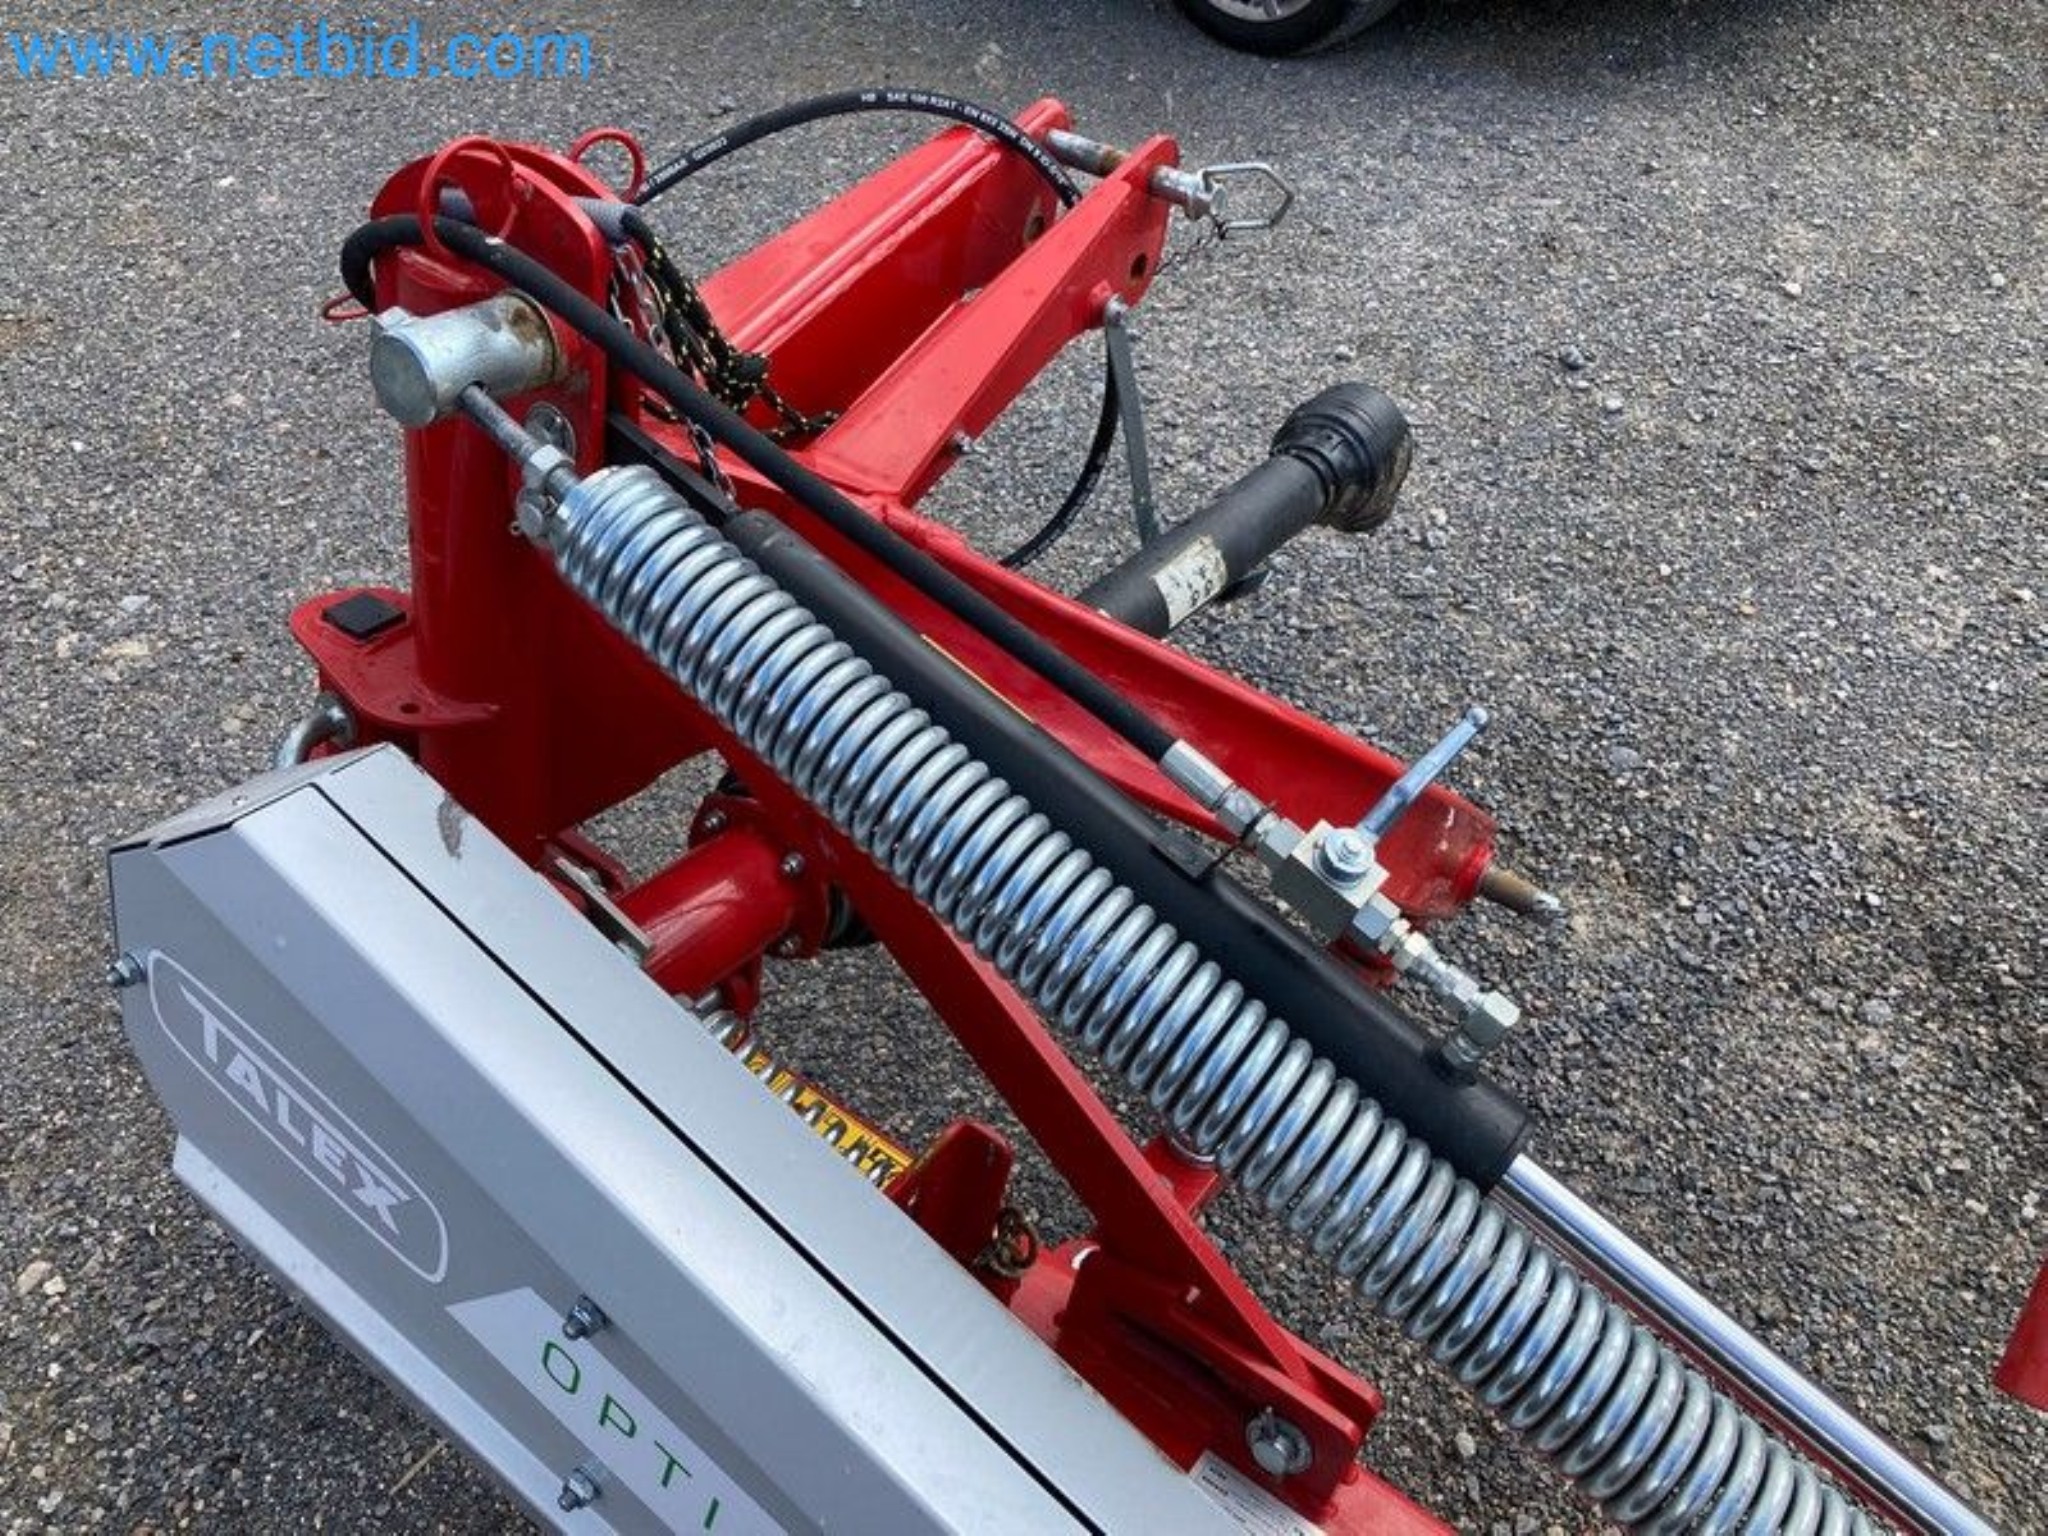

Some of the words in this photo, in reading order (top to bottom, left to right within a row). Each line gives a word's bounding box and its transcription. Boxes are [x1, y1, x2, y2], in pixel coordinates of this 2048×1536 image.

[886, 92, 908, 103] SAE
[929, 95, 958, 110] R2AT
[963, 104, 981, 119] EN
[178, 982, 411, 1235] TALEX
[541, 1340, 720, 1529] OPTI
